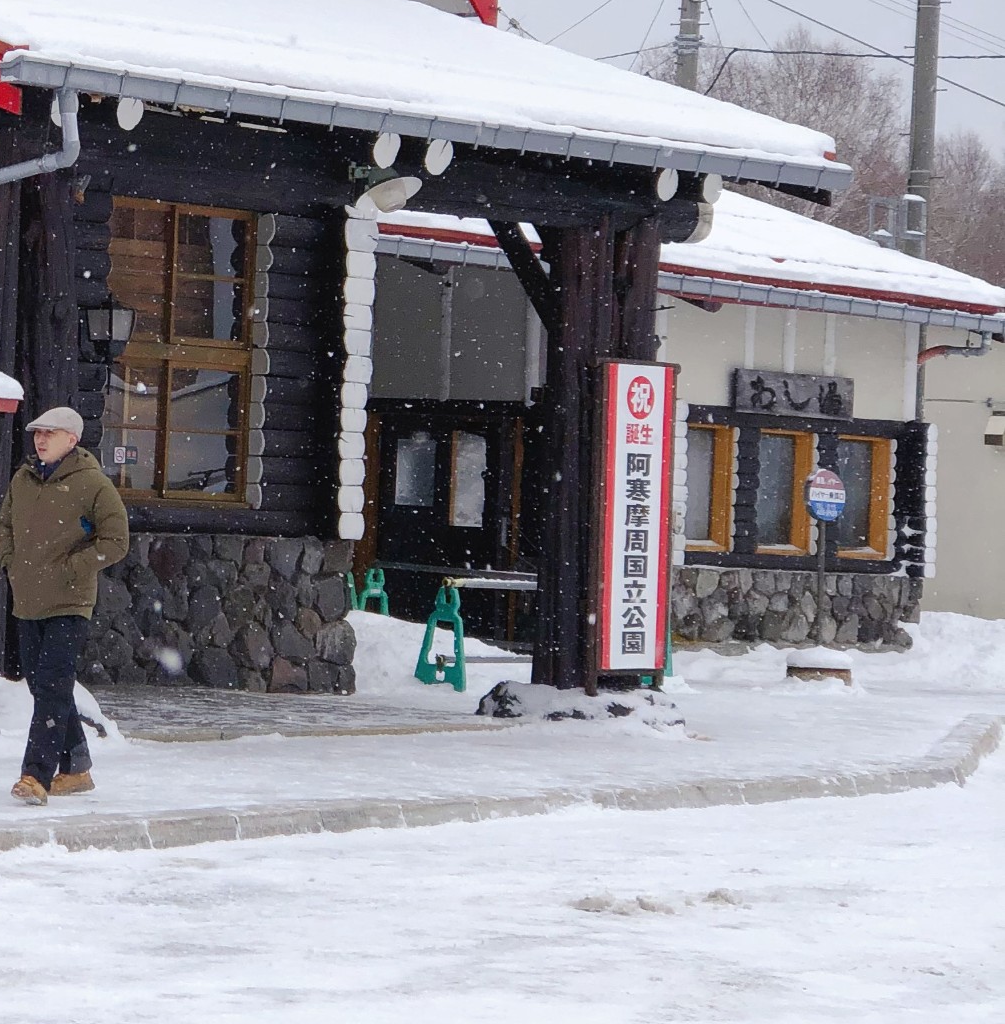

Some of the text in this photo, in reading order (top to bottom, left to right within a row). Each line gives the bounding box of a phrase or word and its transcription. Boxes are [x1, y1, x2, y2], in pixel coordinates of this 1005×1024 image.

[631, 382, 652, 414] 祝
[625, 423, 654, 446] 誕生
[621, 452, 652, 656] 阿寒摩周国立公園
